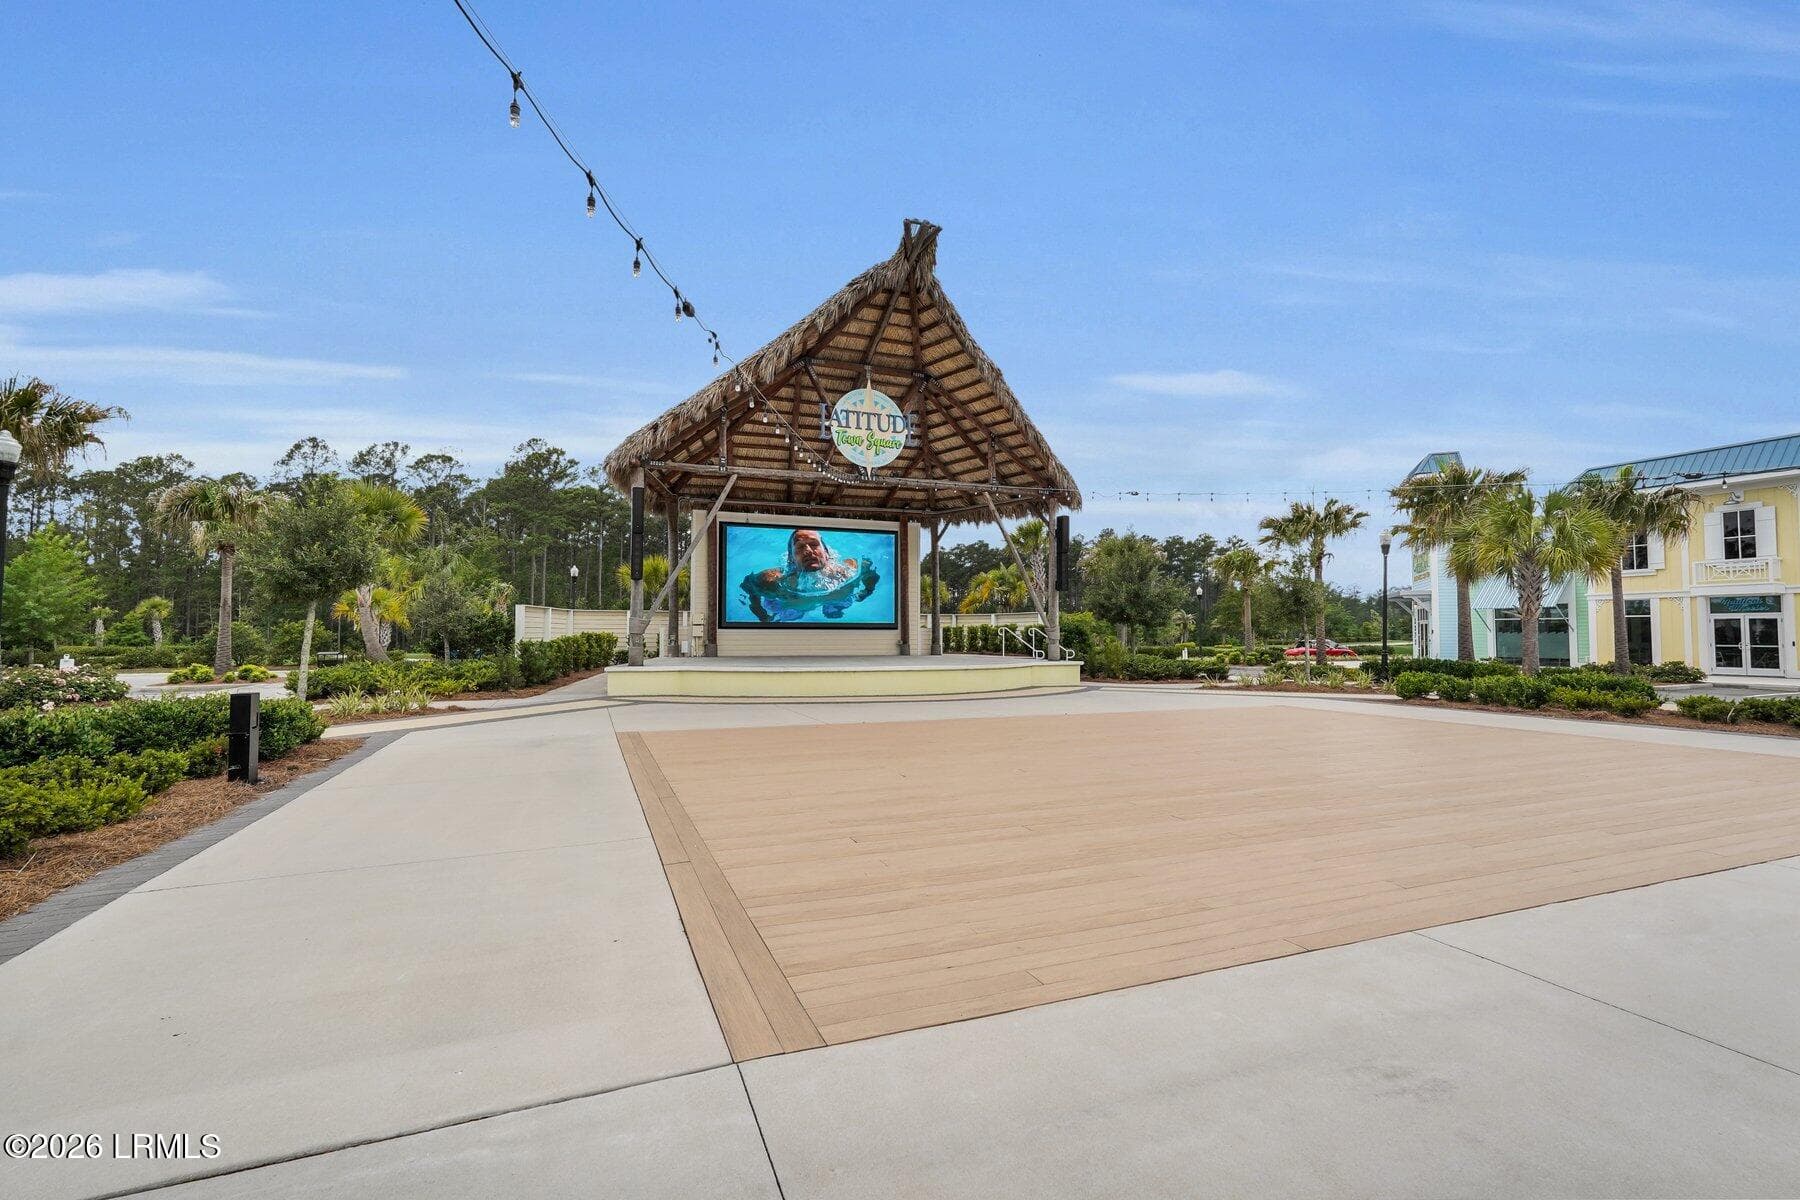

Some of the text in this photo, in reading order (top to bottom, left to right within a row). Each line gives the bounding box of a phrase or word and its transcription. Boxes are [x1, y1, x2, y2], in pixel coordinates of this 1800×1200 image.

[819, 403, 920, 447] LATITUDE
[835, 429, 902, 455] Town Square
